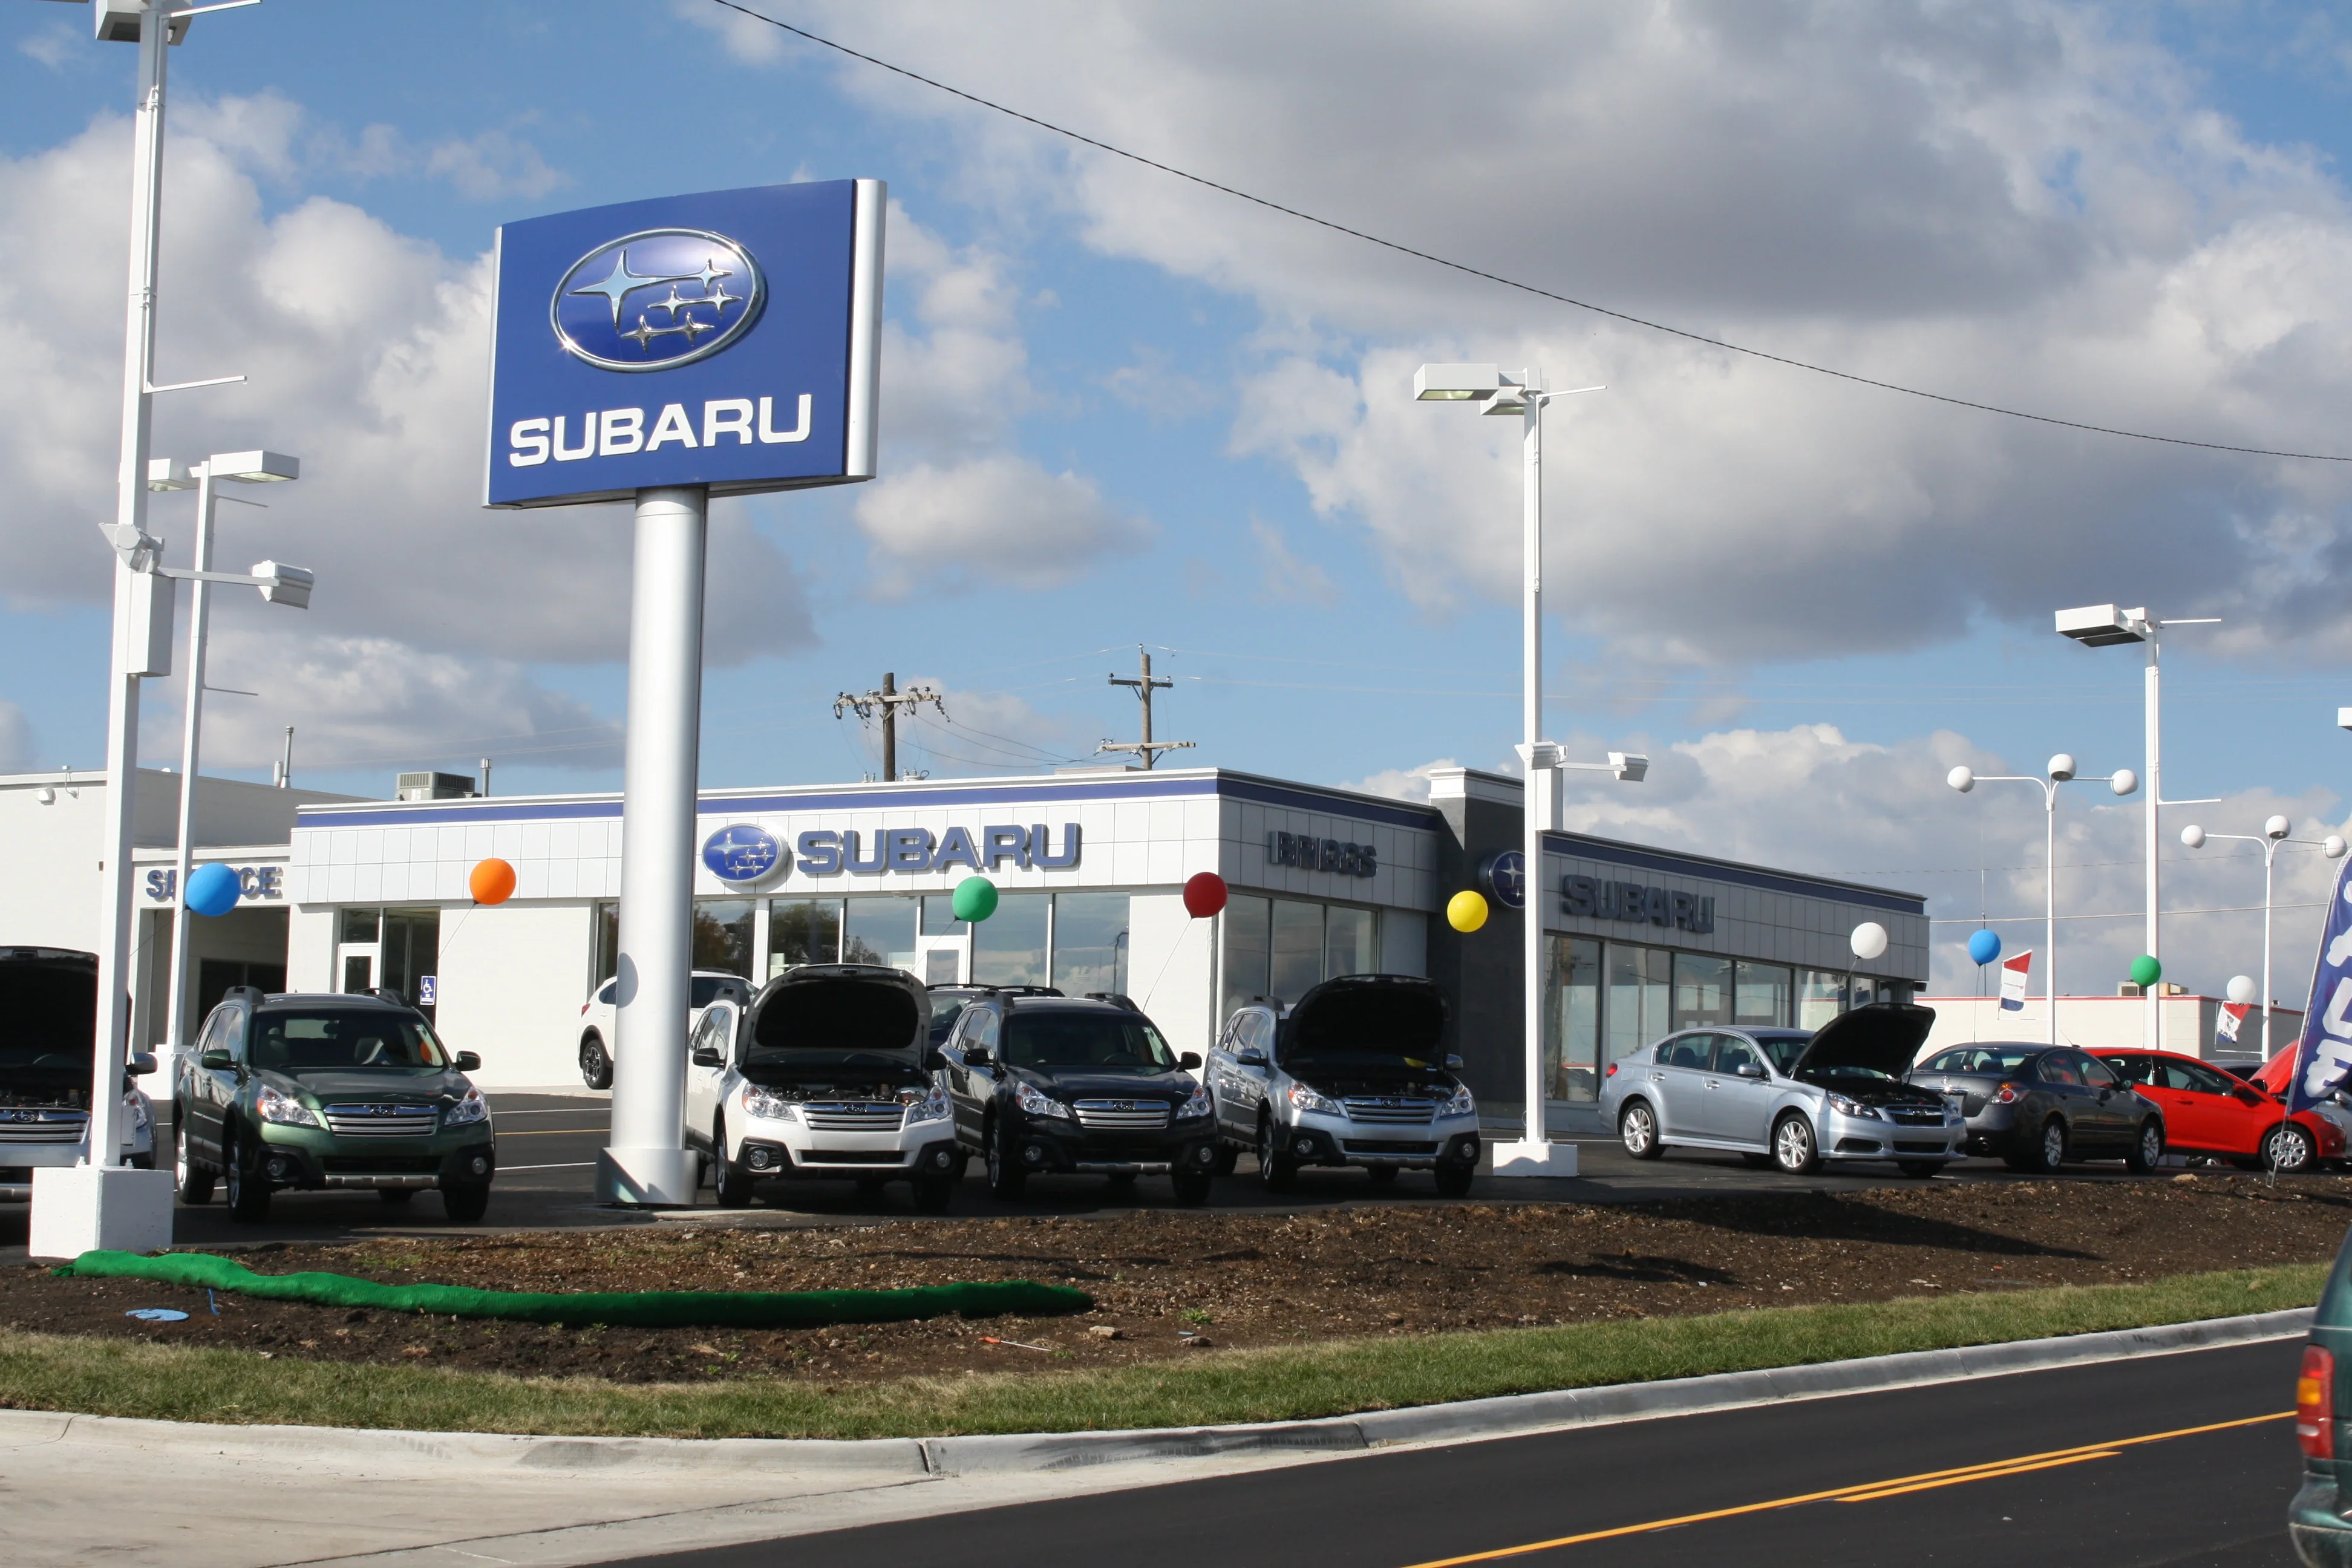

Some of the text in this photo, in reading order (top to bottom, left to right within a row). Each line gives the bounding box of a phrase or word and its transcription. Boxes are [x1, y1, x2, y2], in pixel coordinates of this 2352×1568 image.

[509, 394, 812, 468] SUBARU
[797, 822, 1081, 874] SUBARU
[1270, 831, 1377, 878] BRIGGS
[1562, 874, 1716, 933] SUBARU
